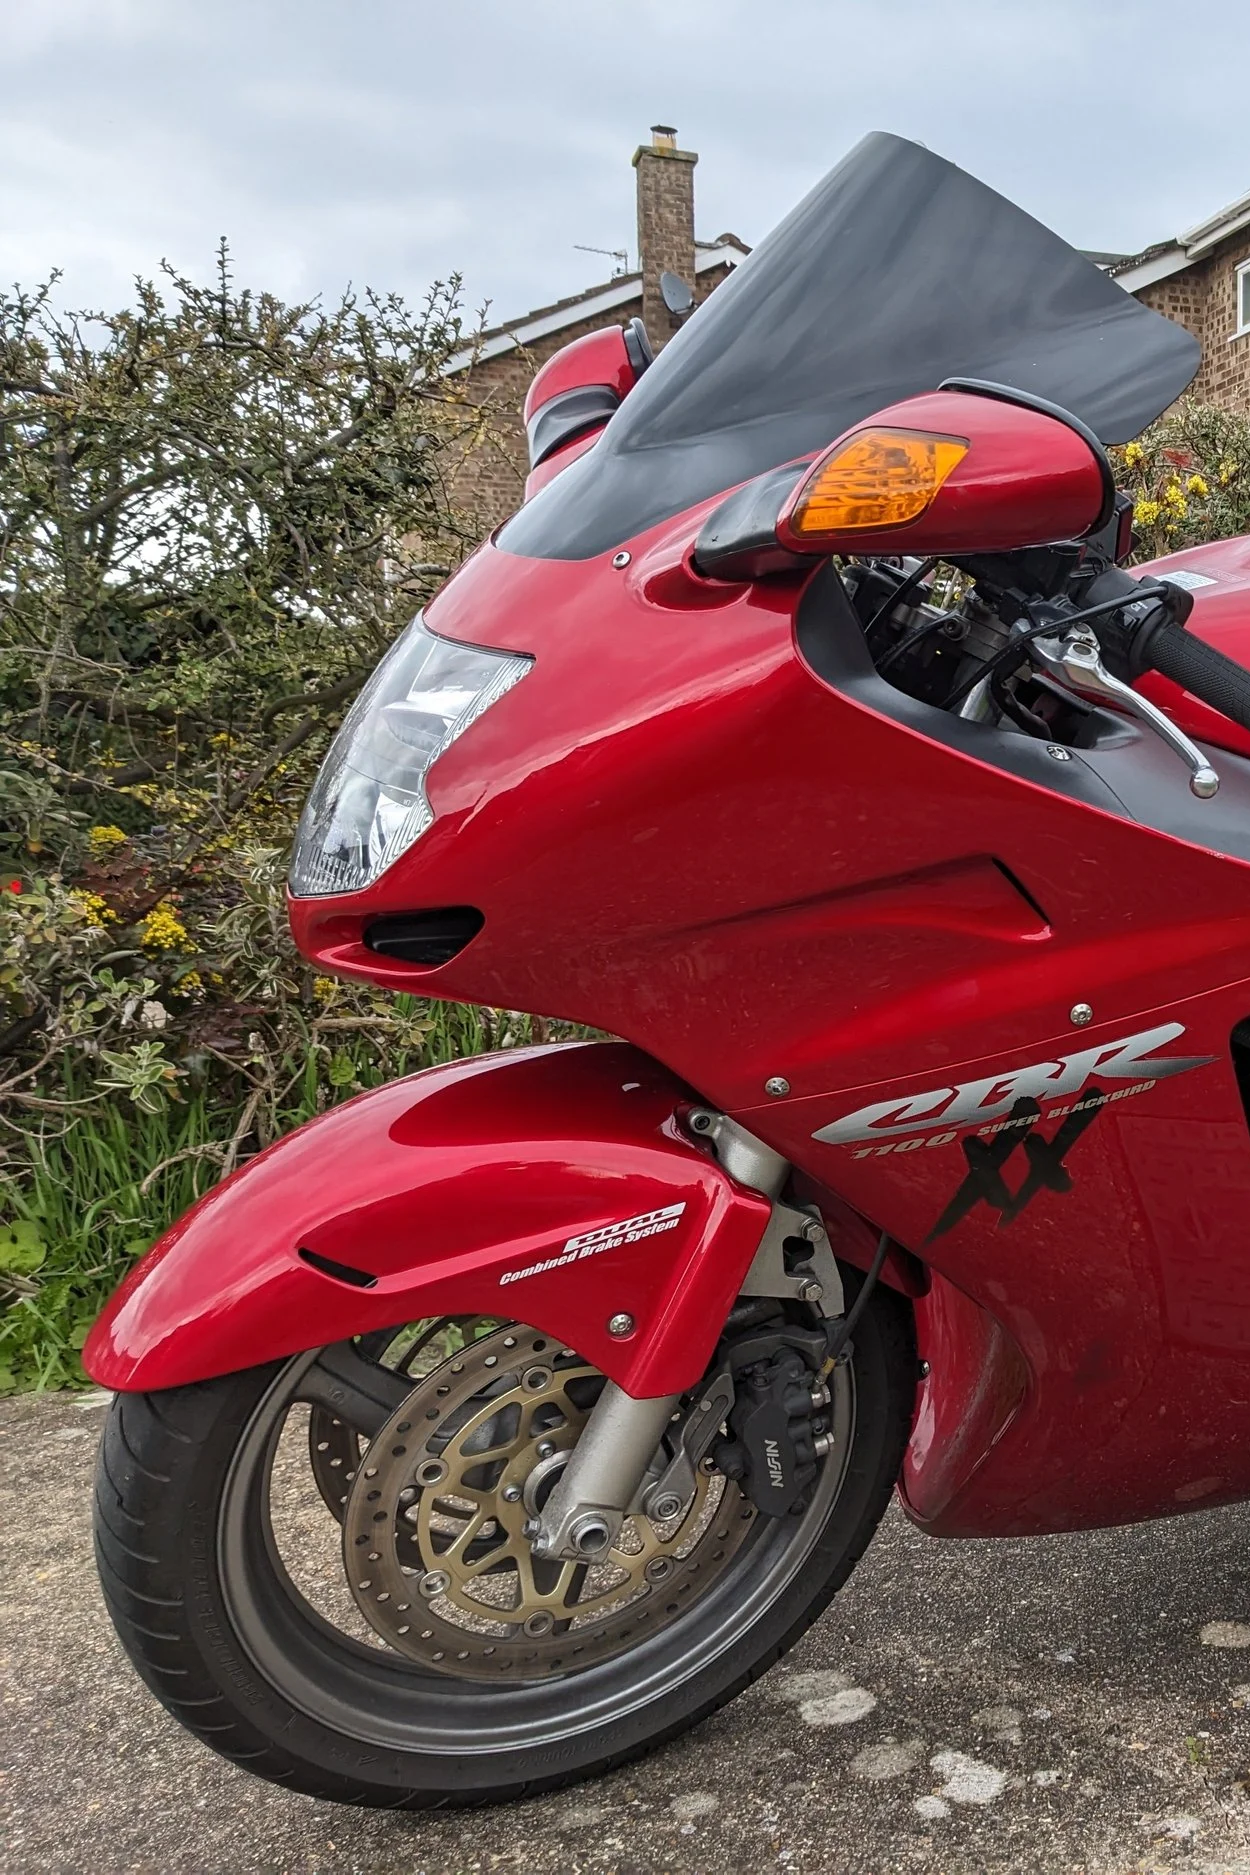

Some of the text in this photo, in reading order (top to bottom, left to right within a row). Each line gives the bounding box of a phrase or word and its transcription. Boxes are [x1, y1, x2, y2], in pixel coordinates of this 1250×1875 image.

[811, 1022, 1222, 1144] CBR
[852, 1079, 1156, 1160] 1100 SUPER BLACKBIRD
[921, 1086, 1105, 1248] XX
[499, 1217, 680, 1286] Combined Brake System
